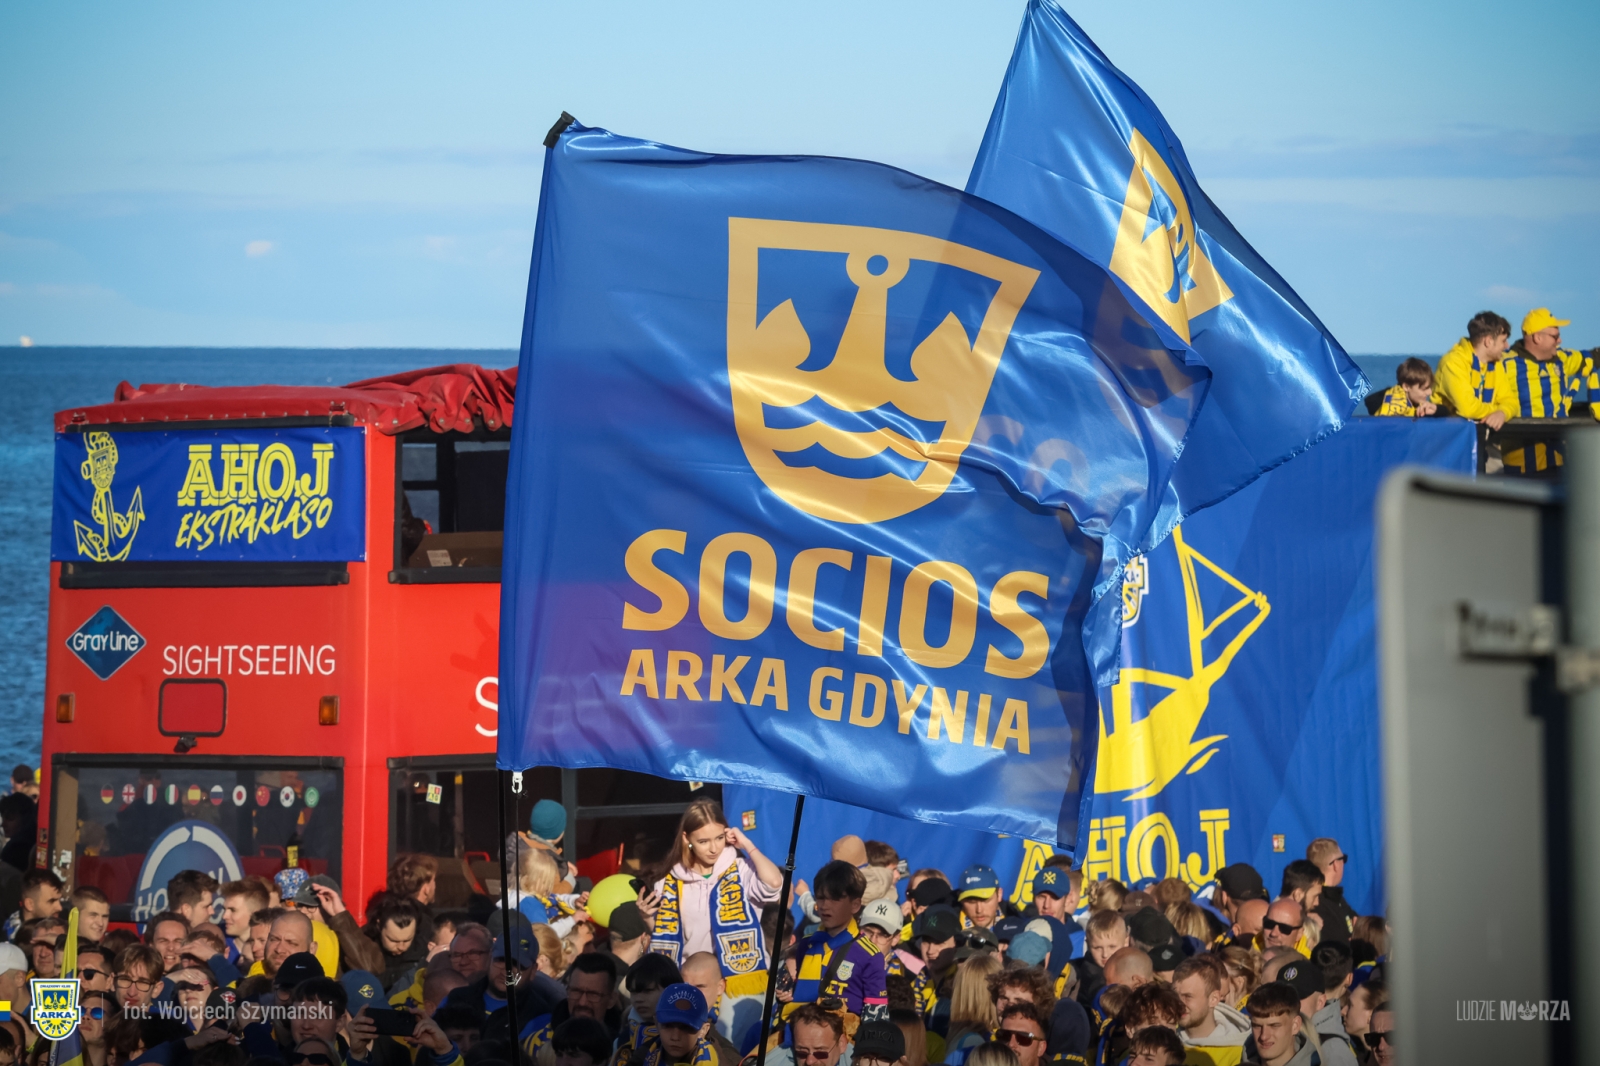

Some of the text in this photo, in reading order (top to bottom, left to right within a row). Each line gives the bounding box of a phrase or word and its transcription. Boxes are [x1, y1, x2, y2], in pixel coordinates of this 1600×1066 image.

[177, 442, 334, 507] AHOJ
[175, 497, 333, 551] EKSTRAKLASO
[621, 529, 1050, 679] SOCIOS
[162, 644, 336, 675] SIGHTSEEING
[619, 649, 1030, 755] ARKA GDYNIA
[729, 953, 755, 961] ARKA
